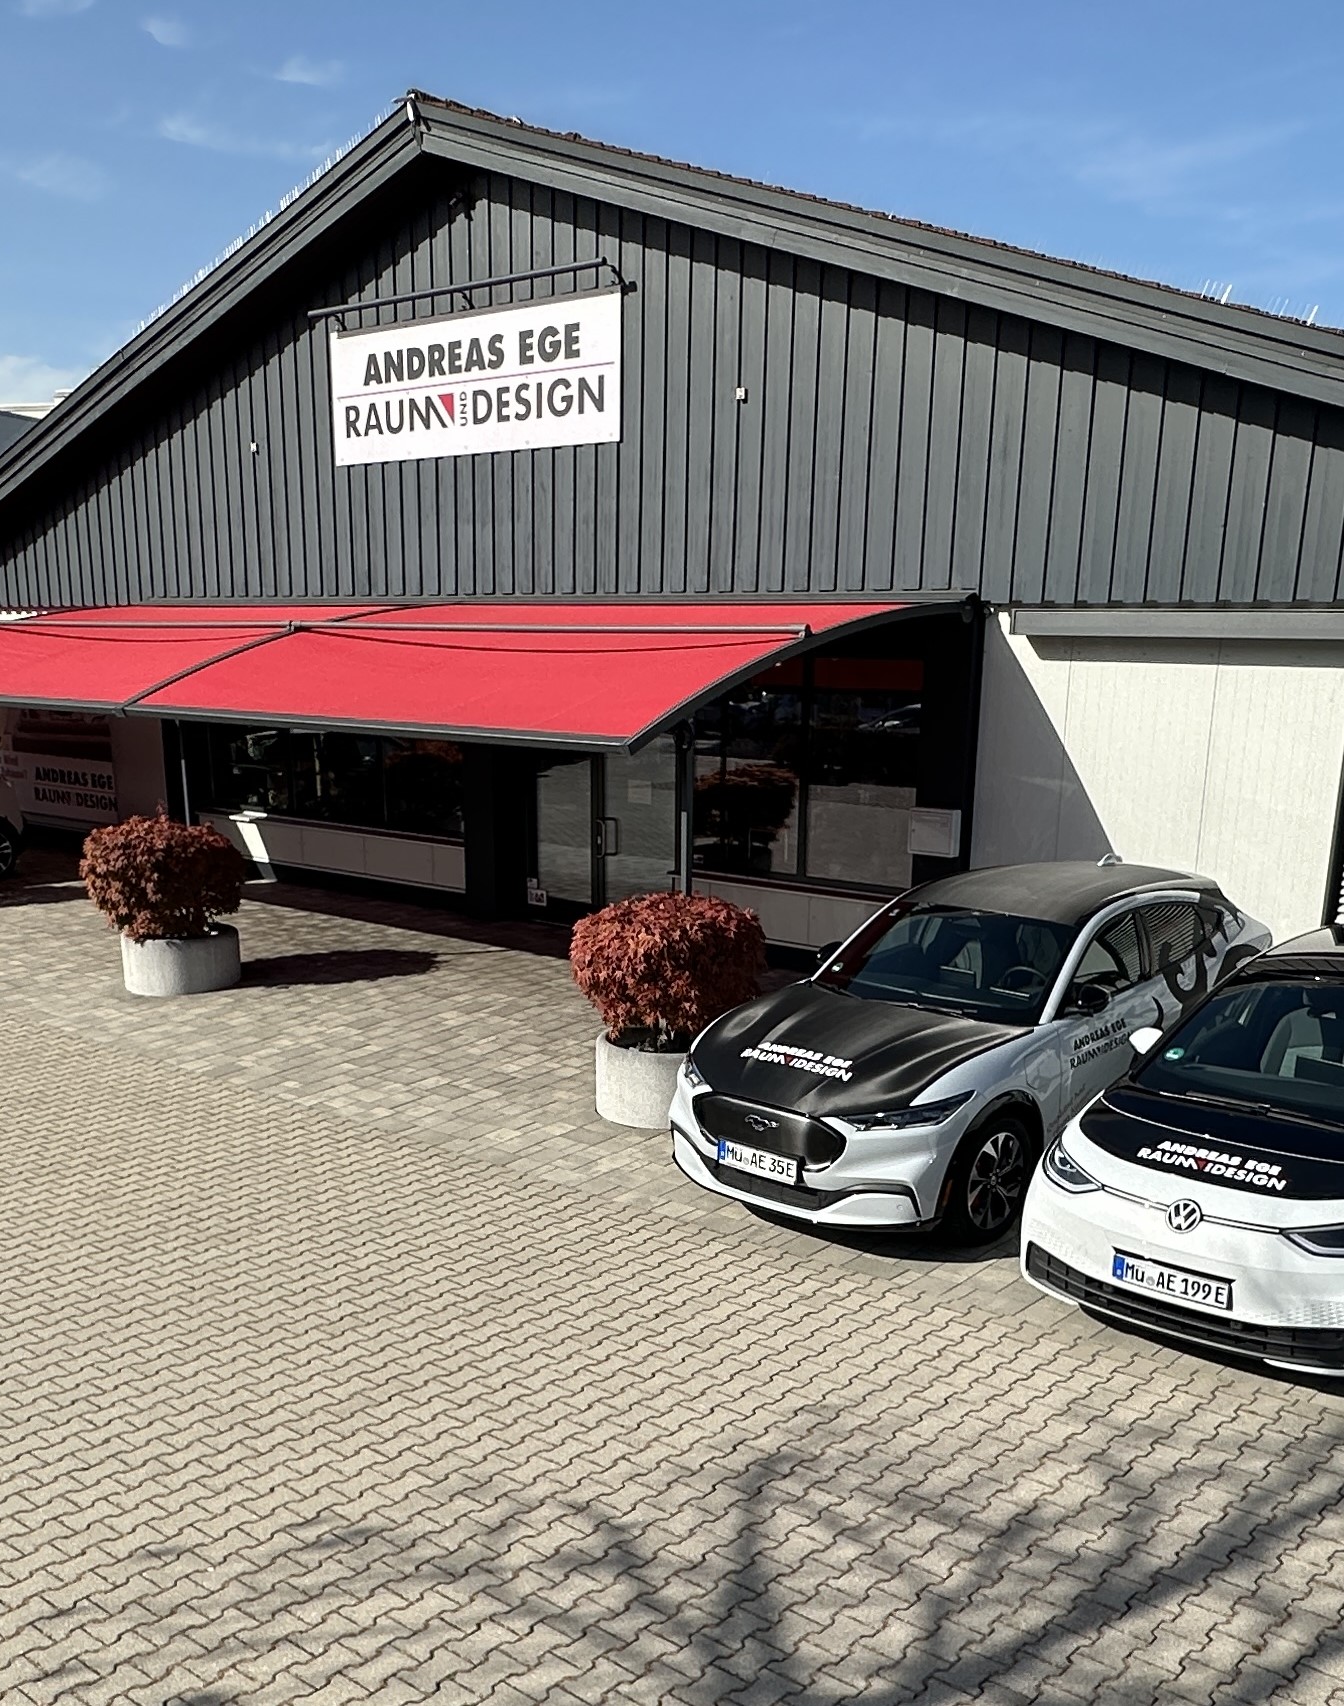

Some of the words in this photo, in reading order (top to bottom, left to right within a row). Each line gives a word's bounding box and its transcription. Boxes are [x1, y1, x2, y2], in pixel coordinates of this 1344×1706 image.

[363, 334, 505, 386] ANDREAS
[518, 322, 581, 366] EGE
[345, 395, 449, 439] RAUM
[472, 375, 605, 425] DESIGN
[35, 766, 88, 787] ANDREAS
[91, 772, 114, 791] EGE
[75, 796, 119, 813] DESIGN
[757, 1041, 824, 1061] ANDREAS
[1073, 1026, 1110, 1051] ANDREAS
[1111, 1018, 1127, 1034] EGE
[740, 1048, 786, 1065] RAUM
[793, 1059, 853, 1082] DESIGN
[750, 1152, 767, 1171] AE
[1136, 1147, 1198, 1170] RAUM
[1210, 1164, 1287, 1191] DESIGN
[1157, 1140, 1243, 1166] ANDREAS
[1244, 1159, 1282, 1176] EGE
[1155, 1271, 1177, 1293] AE
